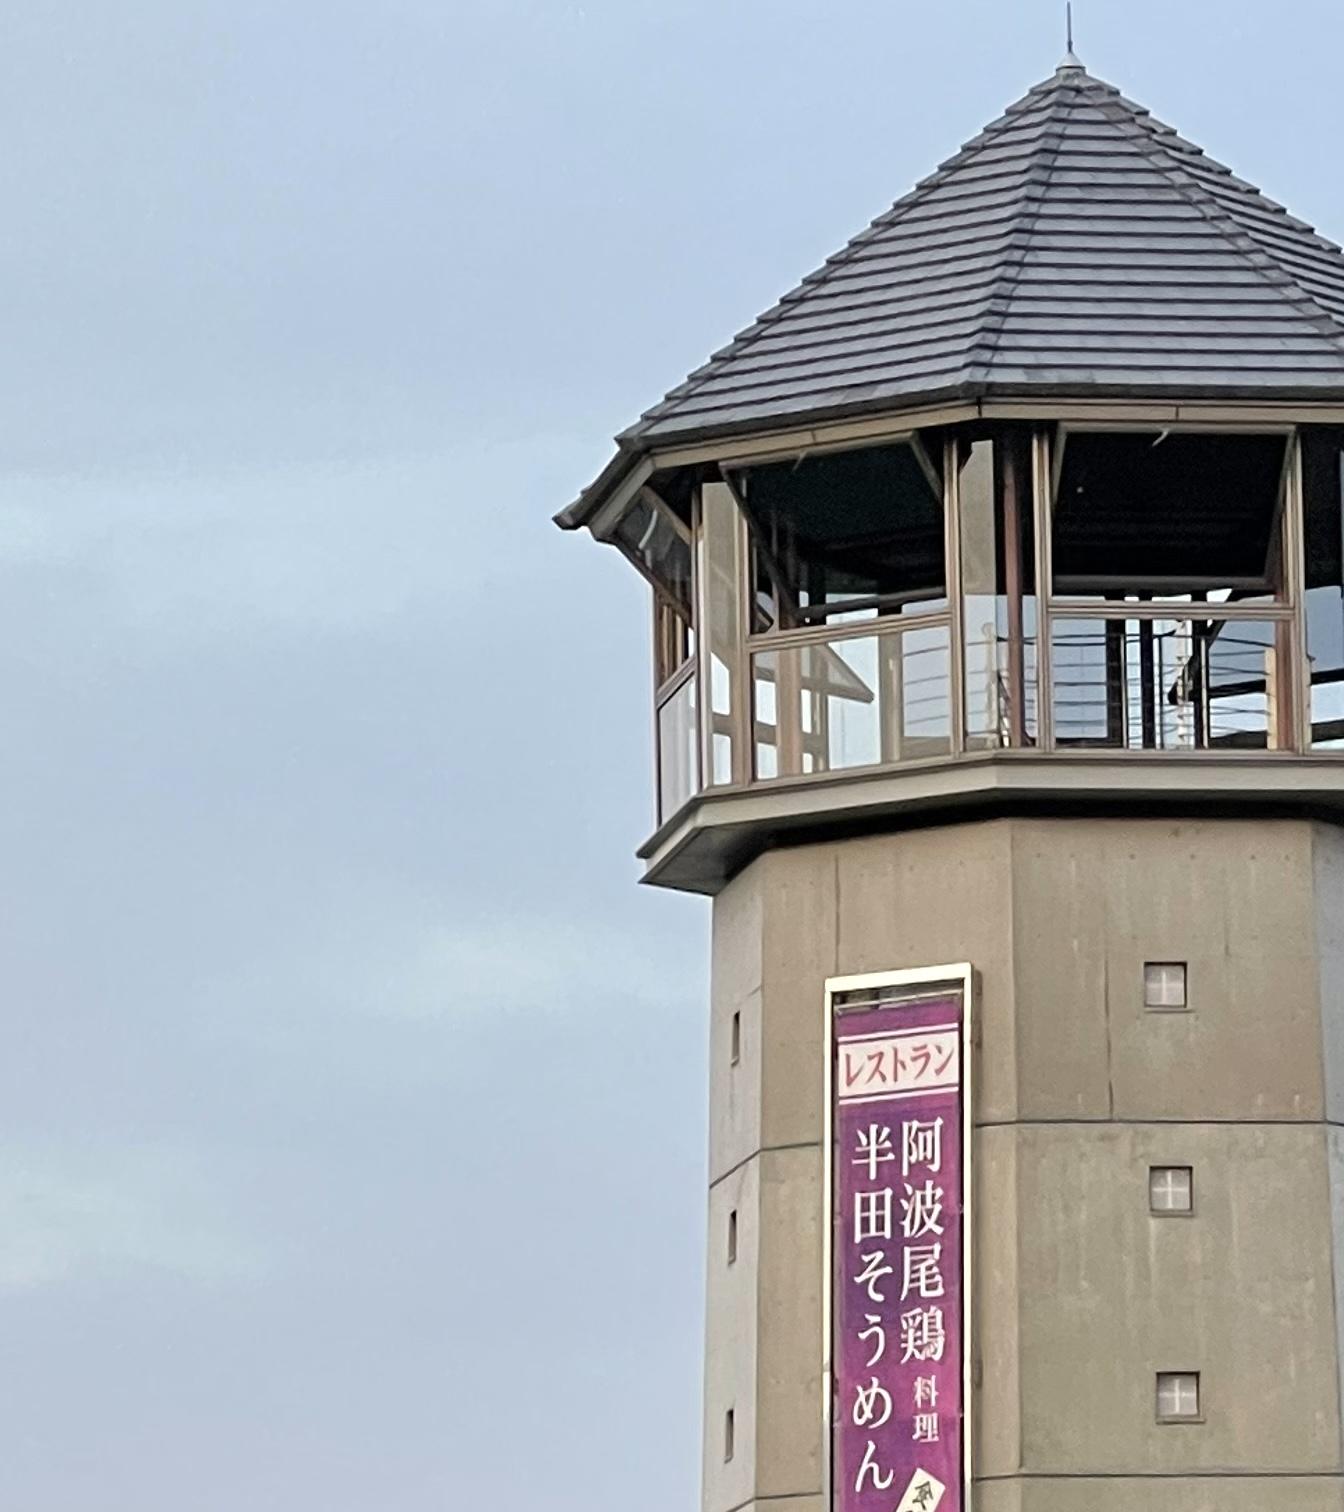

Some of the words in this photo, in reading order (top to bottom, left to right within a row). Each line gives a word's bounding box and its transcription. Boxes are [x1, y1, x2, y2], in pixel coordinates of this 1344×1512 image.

[844, 1043, 956, 1088] レストラン
[852, 1122, 894, 1493] 半田そうめん
